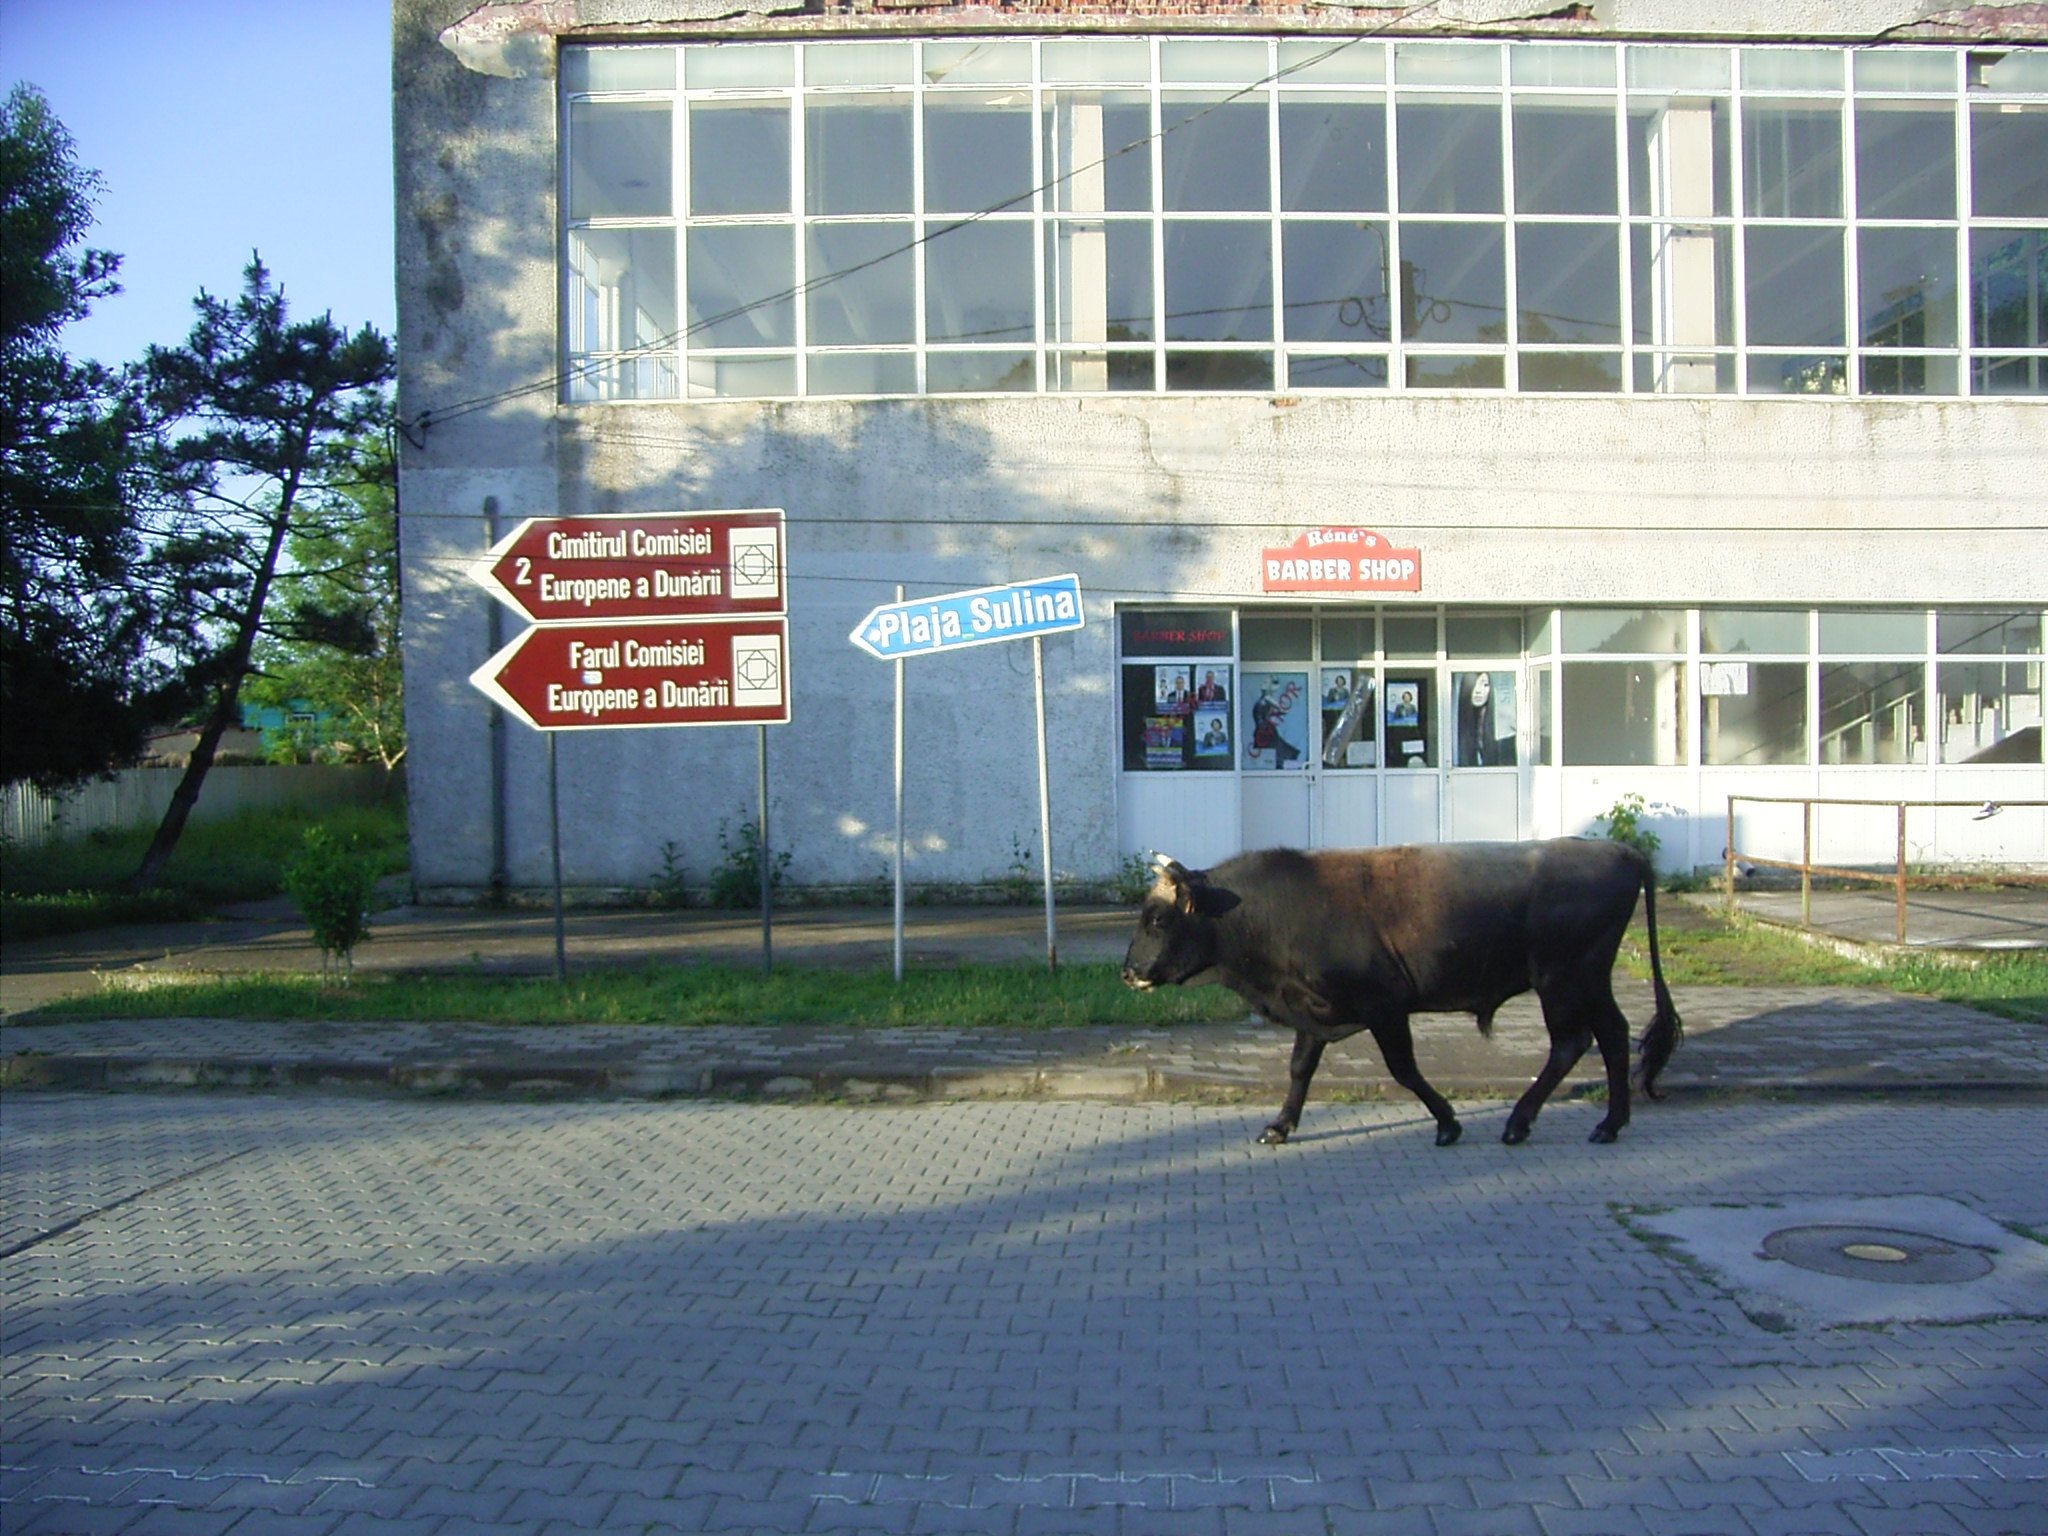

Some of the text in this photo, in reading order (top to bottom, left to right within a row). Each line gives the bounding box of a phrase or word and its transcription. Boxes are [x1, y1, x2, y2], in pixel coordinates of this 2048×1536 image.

[549, 528, 711, 559] Cimitirul Comisiei
[515, 557, 532, 585] 2
[1266, 559, 1415, 581] BARBER SHOP
[541, 573, 631, 606] Europene
[636, 577, 650, 598] a
[878, 590, 1076, 647] Plaja Sulina
[570, 639, 704, 669] Farul Comisiei
[548, 683, 638, 716] Europene
[644, 688, 657, 708] a
